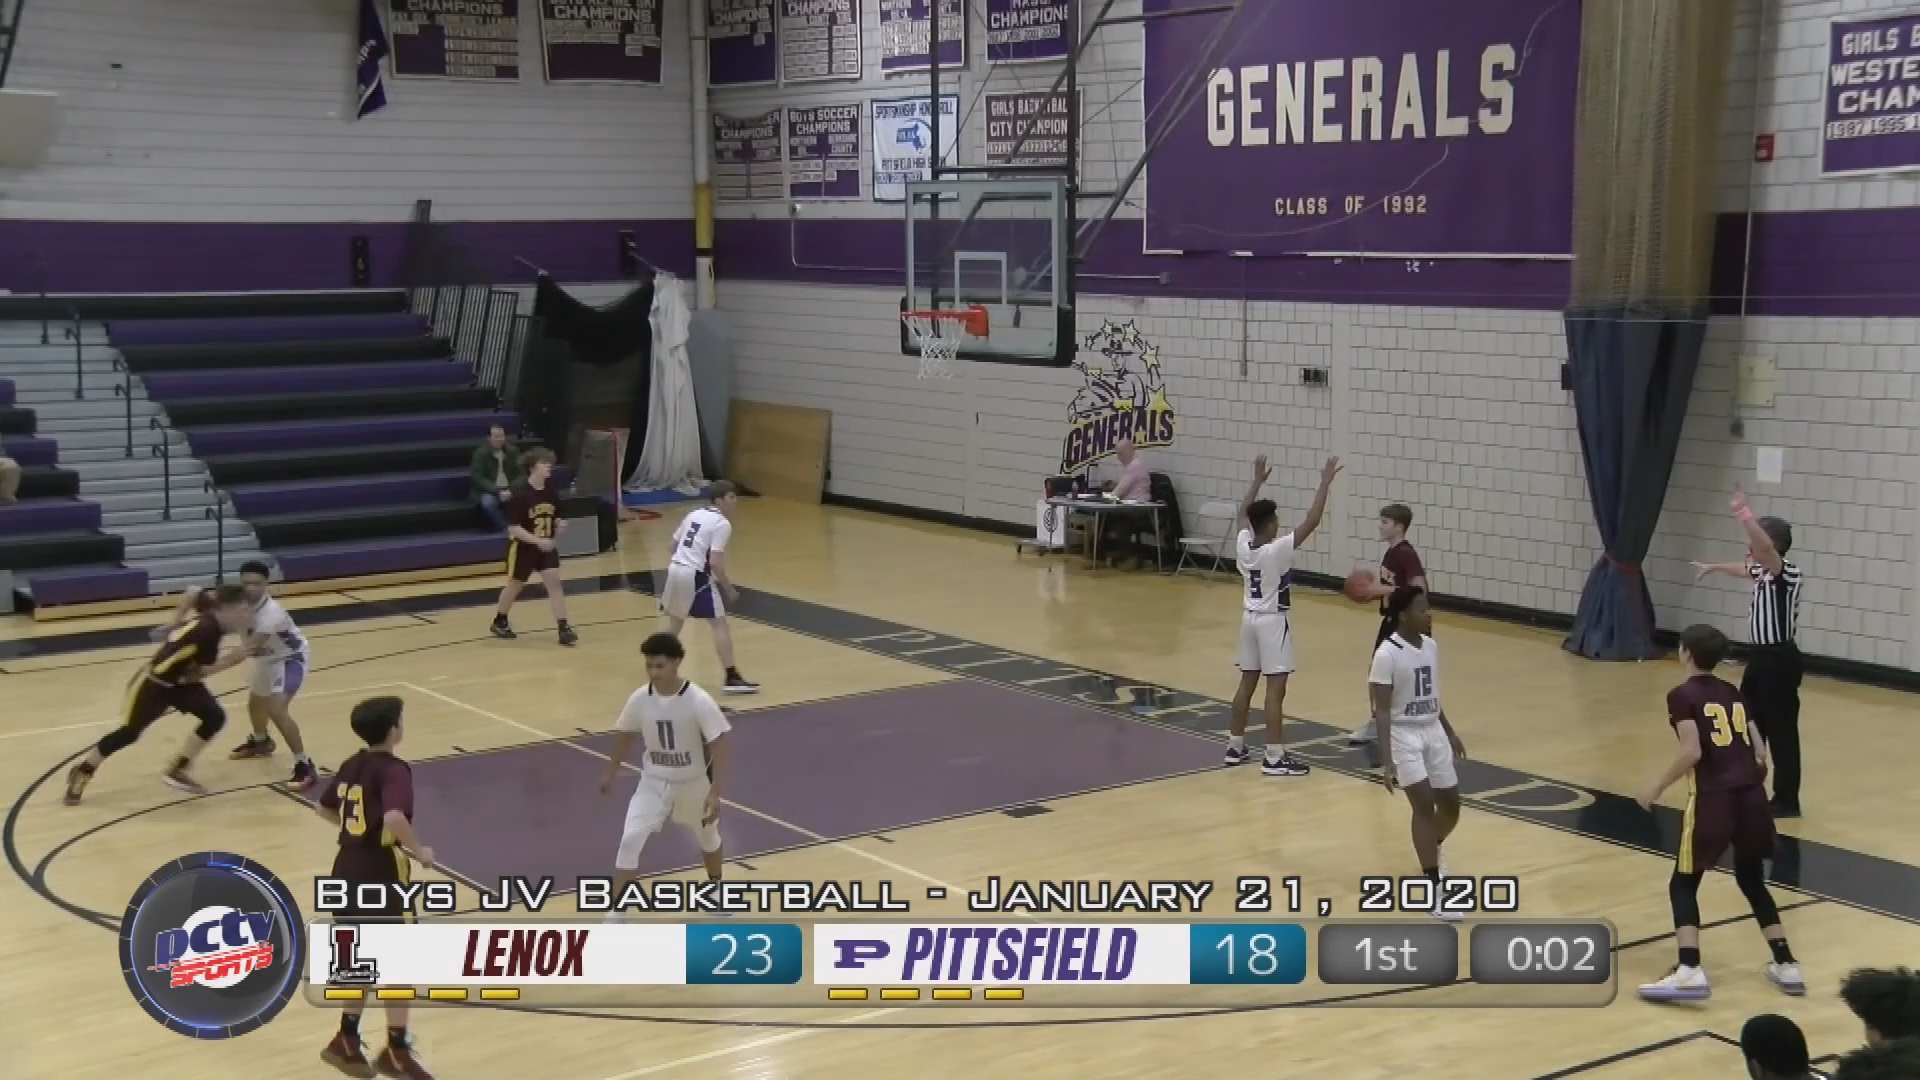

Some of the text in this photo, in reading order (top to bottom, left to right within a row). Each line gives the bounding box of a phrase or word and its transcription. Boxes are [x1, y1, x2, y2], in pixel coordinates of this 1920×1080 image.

[554, 6, 652, 22] CHAMPIONS
[788, 0, 850, 16] CHAMPIONS
[1842, 27, 1899, 56] GIRLS
[1831, 55, 1920, 86] WESTE
[991, 101, 1014, 116] GIRLS
[1207, 43, 1516, 147] GENERALS
[796, 121, 850, 135] CHAMPIONS
[822, 107, 858, 121] SOCCER
[990, 121, 1012, 136] CITY
[1275, 195, 1427, 216] CLASS OF 1992
[1065, 406, 1175, 469] GENERALS
[1248, 569, 1263, 599] 5
[1413, 665, 1433, 697] 12
[656, 719, 676, 751] 11
[1703, 702, 1751, 747] 34
